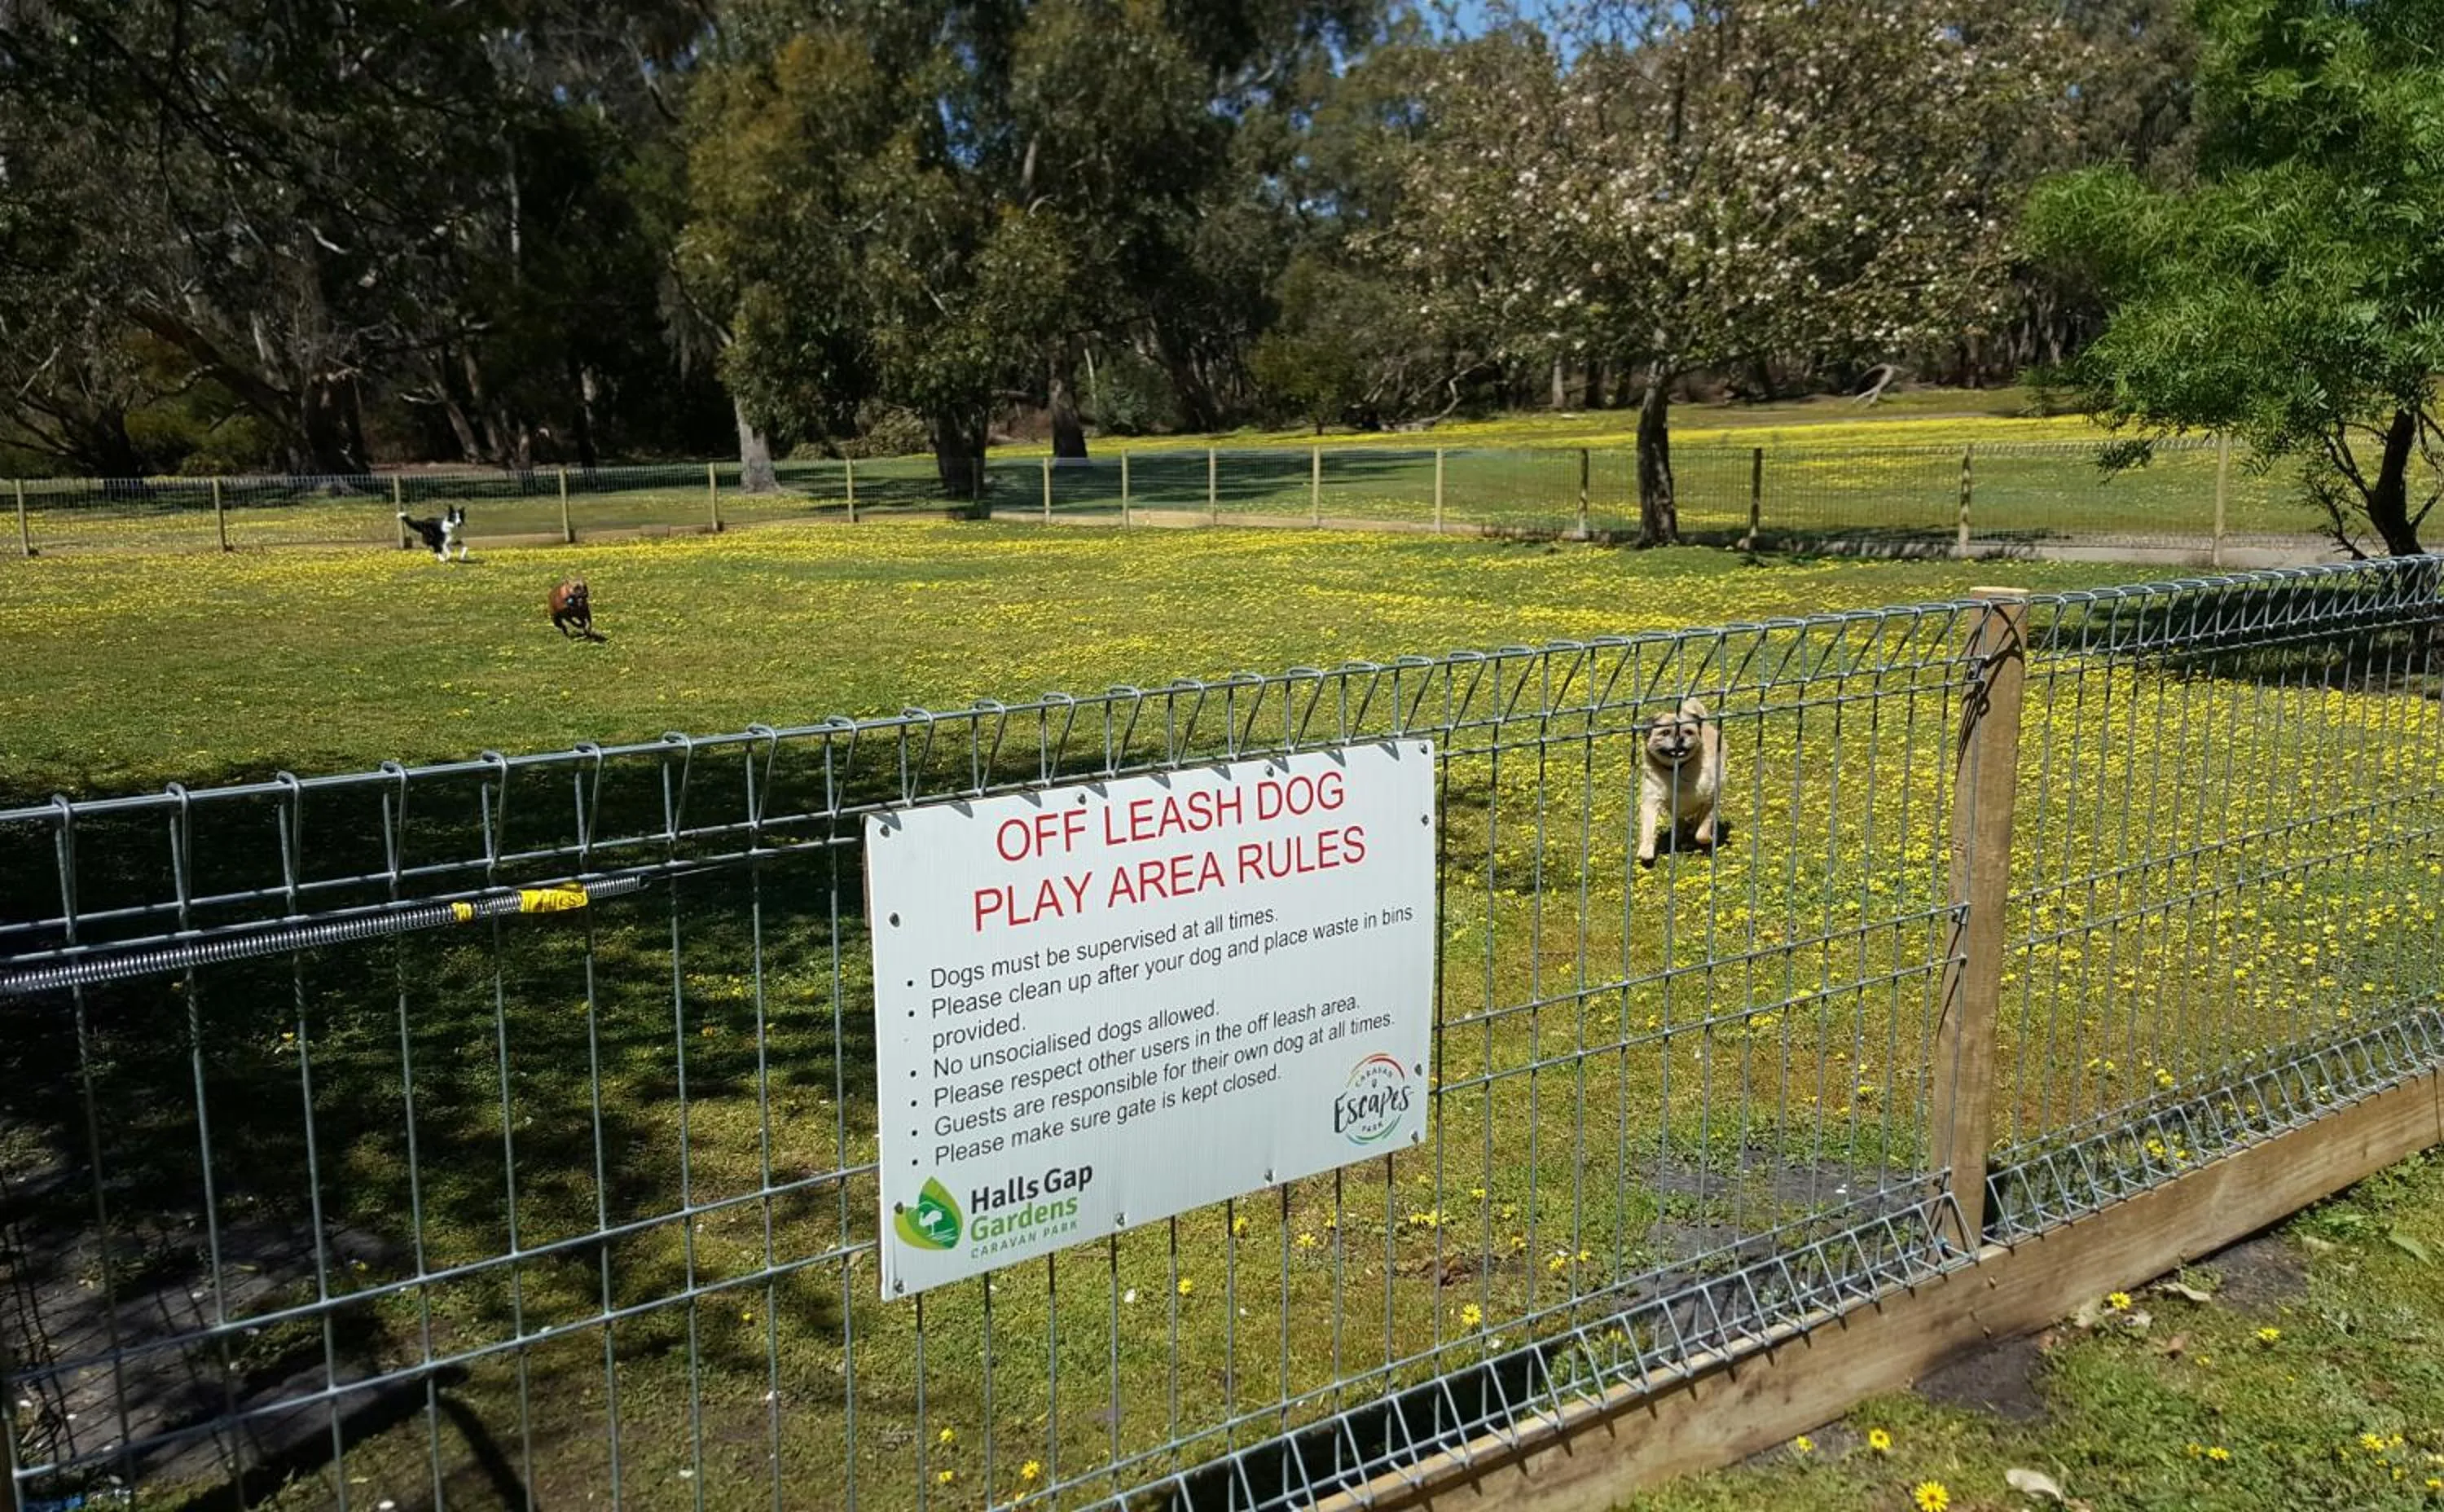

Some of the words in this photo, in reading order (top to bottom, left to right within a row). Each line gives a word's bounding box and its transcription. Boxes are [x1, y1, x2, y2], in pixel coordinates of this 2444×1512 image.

[996, 808, 1088, 862] OFF
[1104, 785, 1242, 846] LEASH
[1257, 771, 1344, 821] DOG
[974, 871, 1093, 933] PLAY
[1107, 851, 1226, 909] AREA
[1238, 825, 1365, 885] RULES
[931, 965, 985, 989] Dogs
[991, 951, 1041, 978] must
[1047, 947, 1070, 968] be
[1076, 922, 1177, 961] supervised
[1182, 920, 1199, 940] at
[1204, 914, 1224, 936] all
[1229, 908, 1278, 931] times.
[932, 991, 1003, 1020] Please
[1009, 980, 1062, 1004] clean
[1068, 974, 1092, 994] up
[1097, 963, 1140, 986] after
[1145, 954, 1185, 980] your
[1189, 947, 1222, 966] dog
[1228, 934, 1259, 959] and
[1264, 929, 1308, 956] place
[1312, 916, 1359, 940] waste
[1364, 912, 1378, 930] in
[1382, 907, 1413, 926] bins
[933, 1012, 1026, 1051] provided.
[934, 1057, 964, 1079] No
[970, 1025, 1092, 1070] unsocialised
[1097, 1019, 1142, 1043] dogs
[1148, 998, 1220, 1031] allowed.
[934, 1079, 1004, 1109] Please
[1011, 1057, 1083, 1092] respect
[1088, 1048, 1136, 1072] other
[1141, 1035, 1190, 1060] users
[1195, 1029, 1211, 1048] in
[1215, 1022, 1242, 1043] the
[1247, 1012, 1269, 1035] off
[1273, 1003, 1317, 1029] leash
[1321, 996, 1360, 1018] area.
[934, 1106, 1008, 1137] Guests
[1013, 1097, 1045, 1119] are
[1052, 1069, 1158, 1110] responsible
[1163, 1062, 1187, 1083] for
[1192, 1050, 1229, 1075] their
[1234, 1044, 1268, 1065] own
[1273, 1035, 1304, 1055] dog
[1308, 1026, 1324, 1046] at
[1328, 1020, 1346, 1041] all
[1351, 1013, 1395, 1035] times.
[935, 1136, 1004, 1167] Please
[1011, 1121, 1064, 1148] make
[1070, 1110, 1111, 1132] sure
[1117, 1098, 1157, 1125] gate
[1163, 1091, 1176, 1109] is
[1182, 1079, 1218, 1105] kept
[1223, 1062, 1281, 1093] closed.
[1334, 1085, 1414, 1133] Escapes
[970, 1197, 1078, 1242] Gardens
[971, 1176, 1040, 1215] Halls
[1044, 1165, 1093, 1193] Gap
[971, 1233, 1036, 1259] CARAVAN
[1044, 1220, 1077, 1237] PARK
